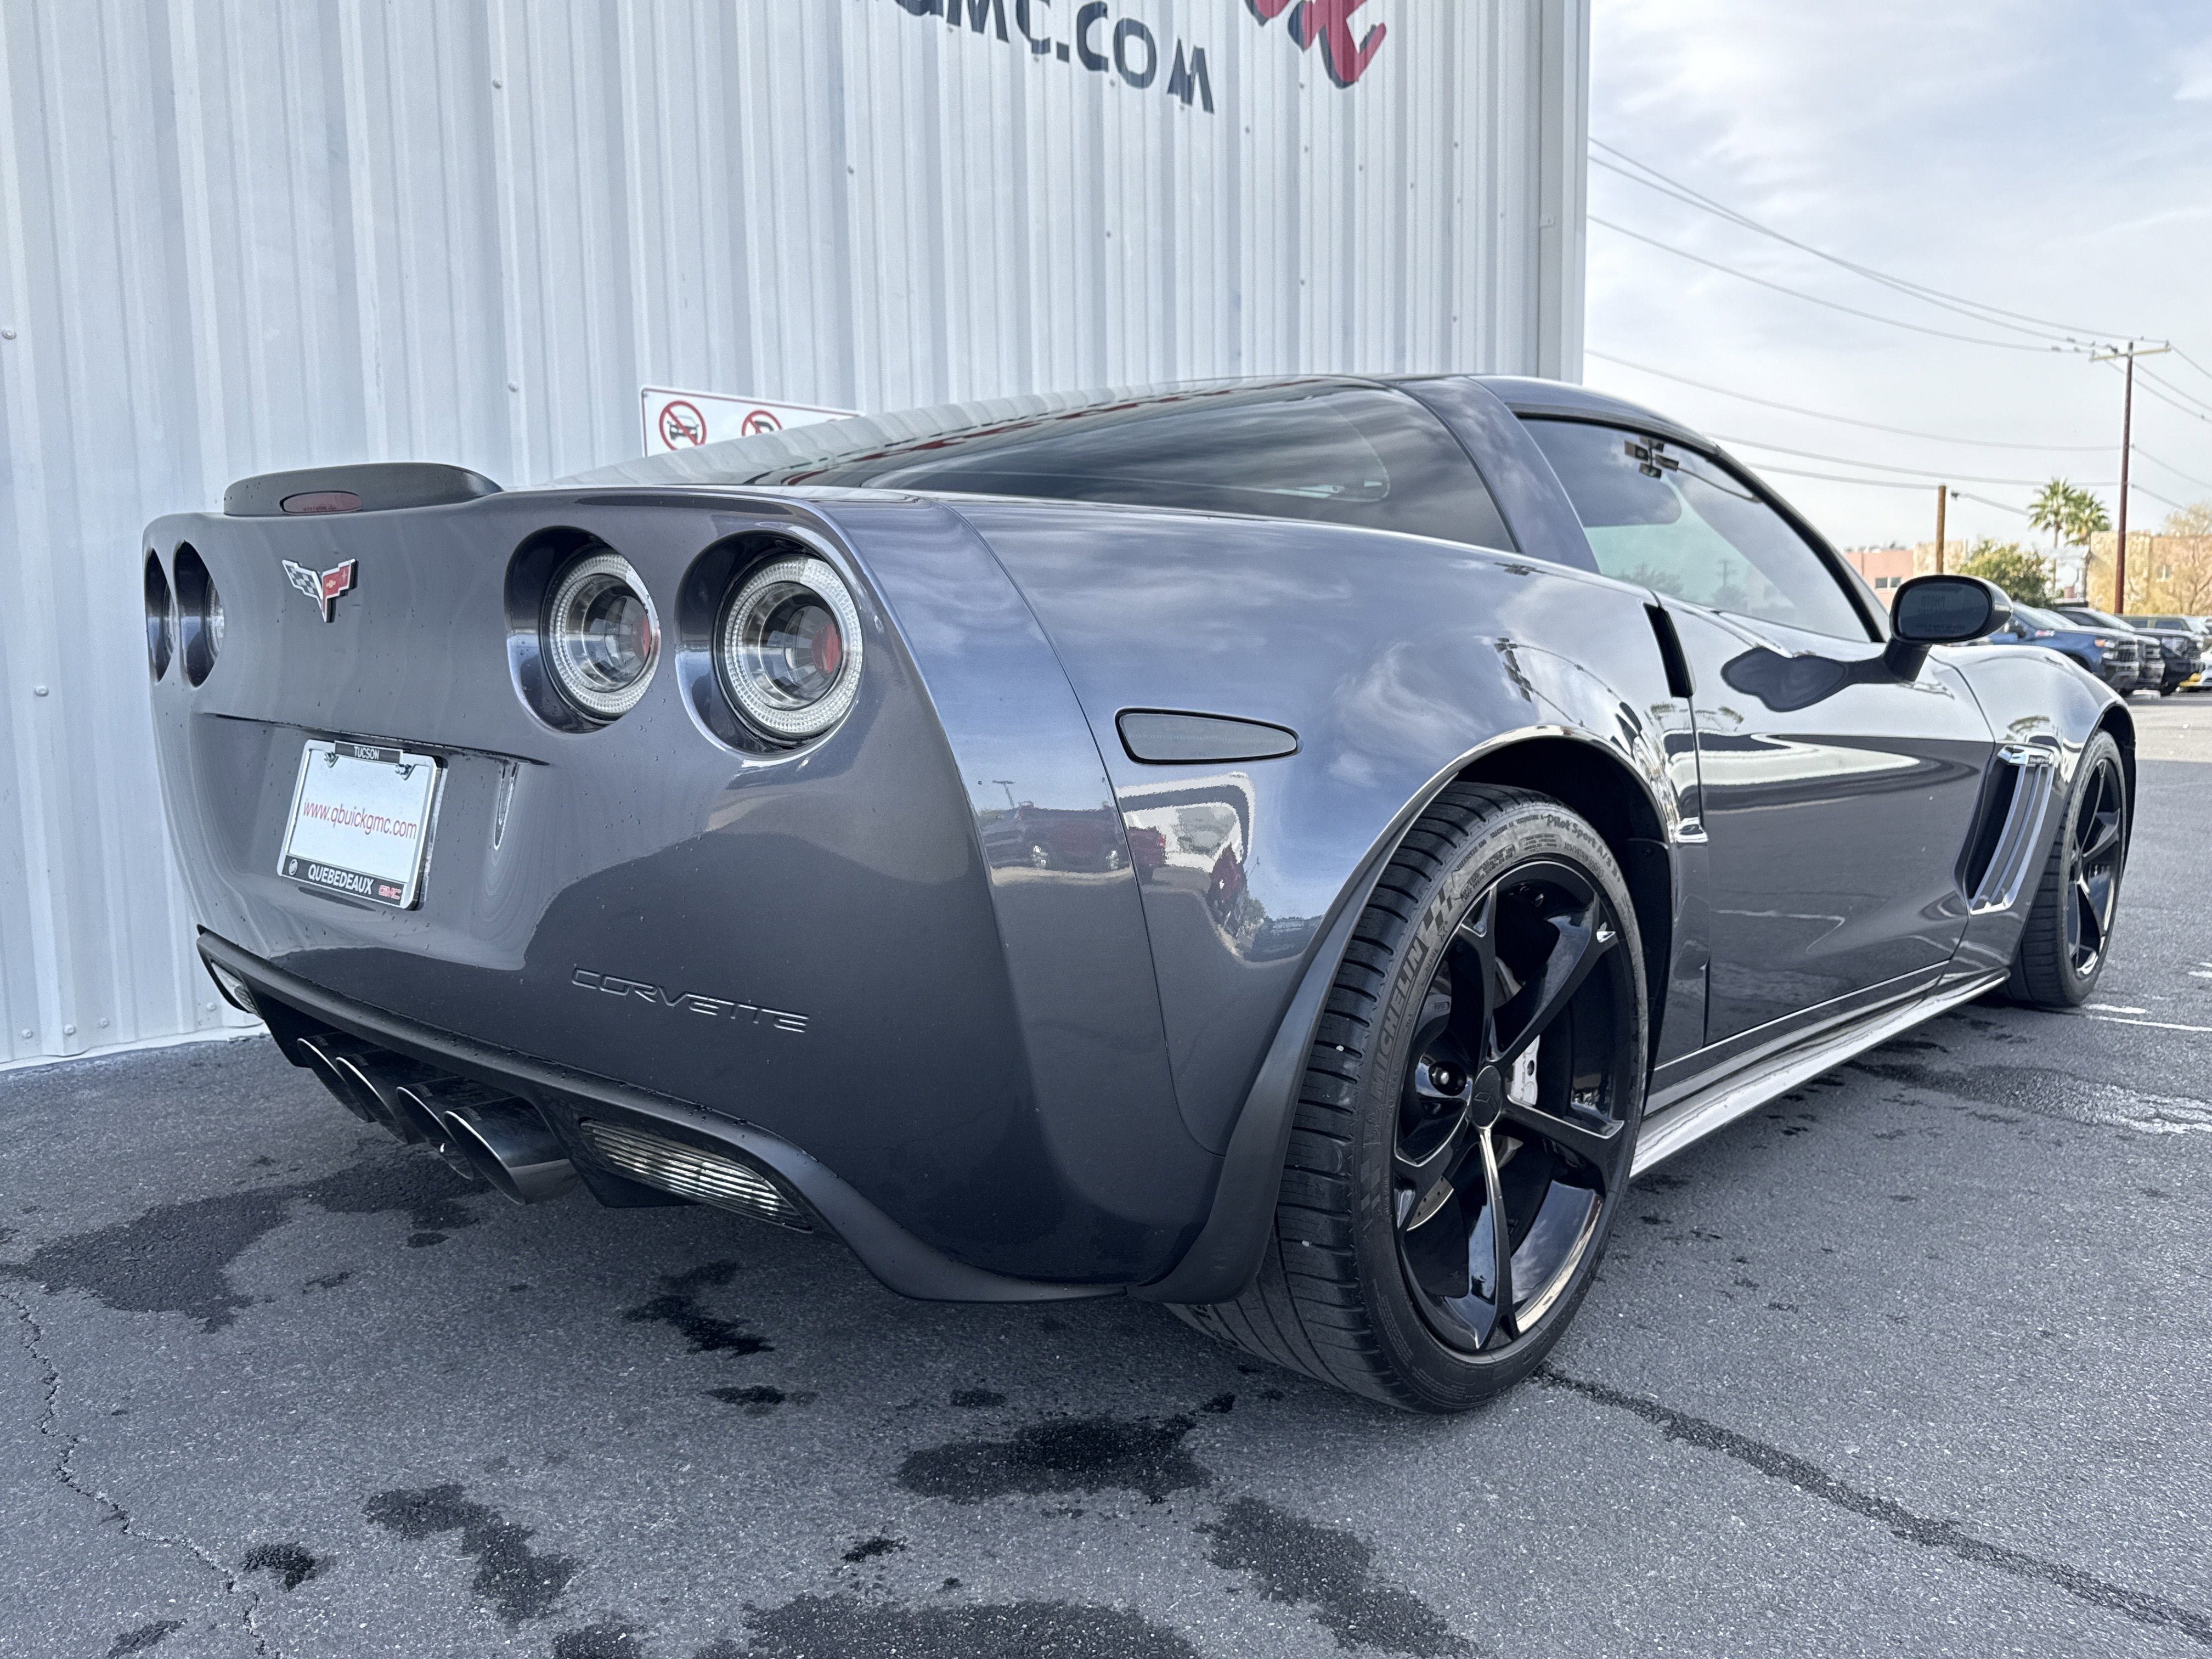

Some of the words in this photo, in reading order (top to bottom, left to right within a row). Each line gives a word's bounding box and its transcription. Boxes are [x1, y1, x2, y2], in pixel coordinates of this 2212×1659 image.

[894, 0, 1214, 114] MC.COM
[354, 746, 380, 760] TUCSON
[303, 801, 417, 840] www.qbuickgmc.com
[1547, 814, 1570, 831] Pilot
[1571, 822, 1597, 849] Sport
[308, 864, 374, 895] QUEBEDEAUX
[378, 885, 402, 900] GMC
[571, 967, 810, 1033] CORVETTE
[1370, 937, 1424, 1104] MICHELIN
